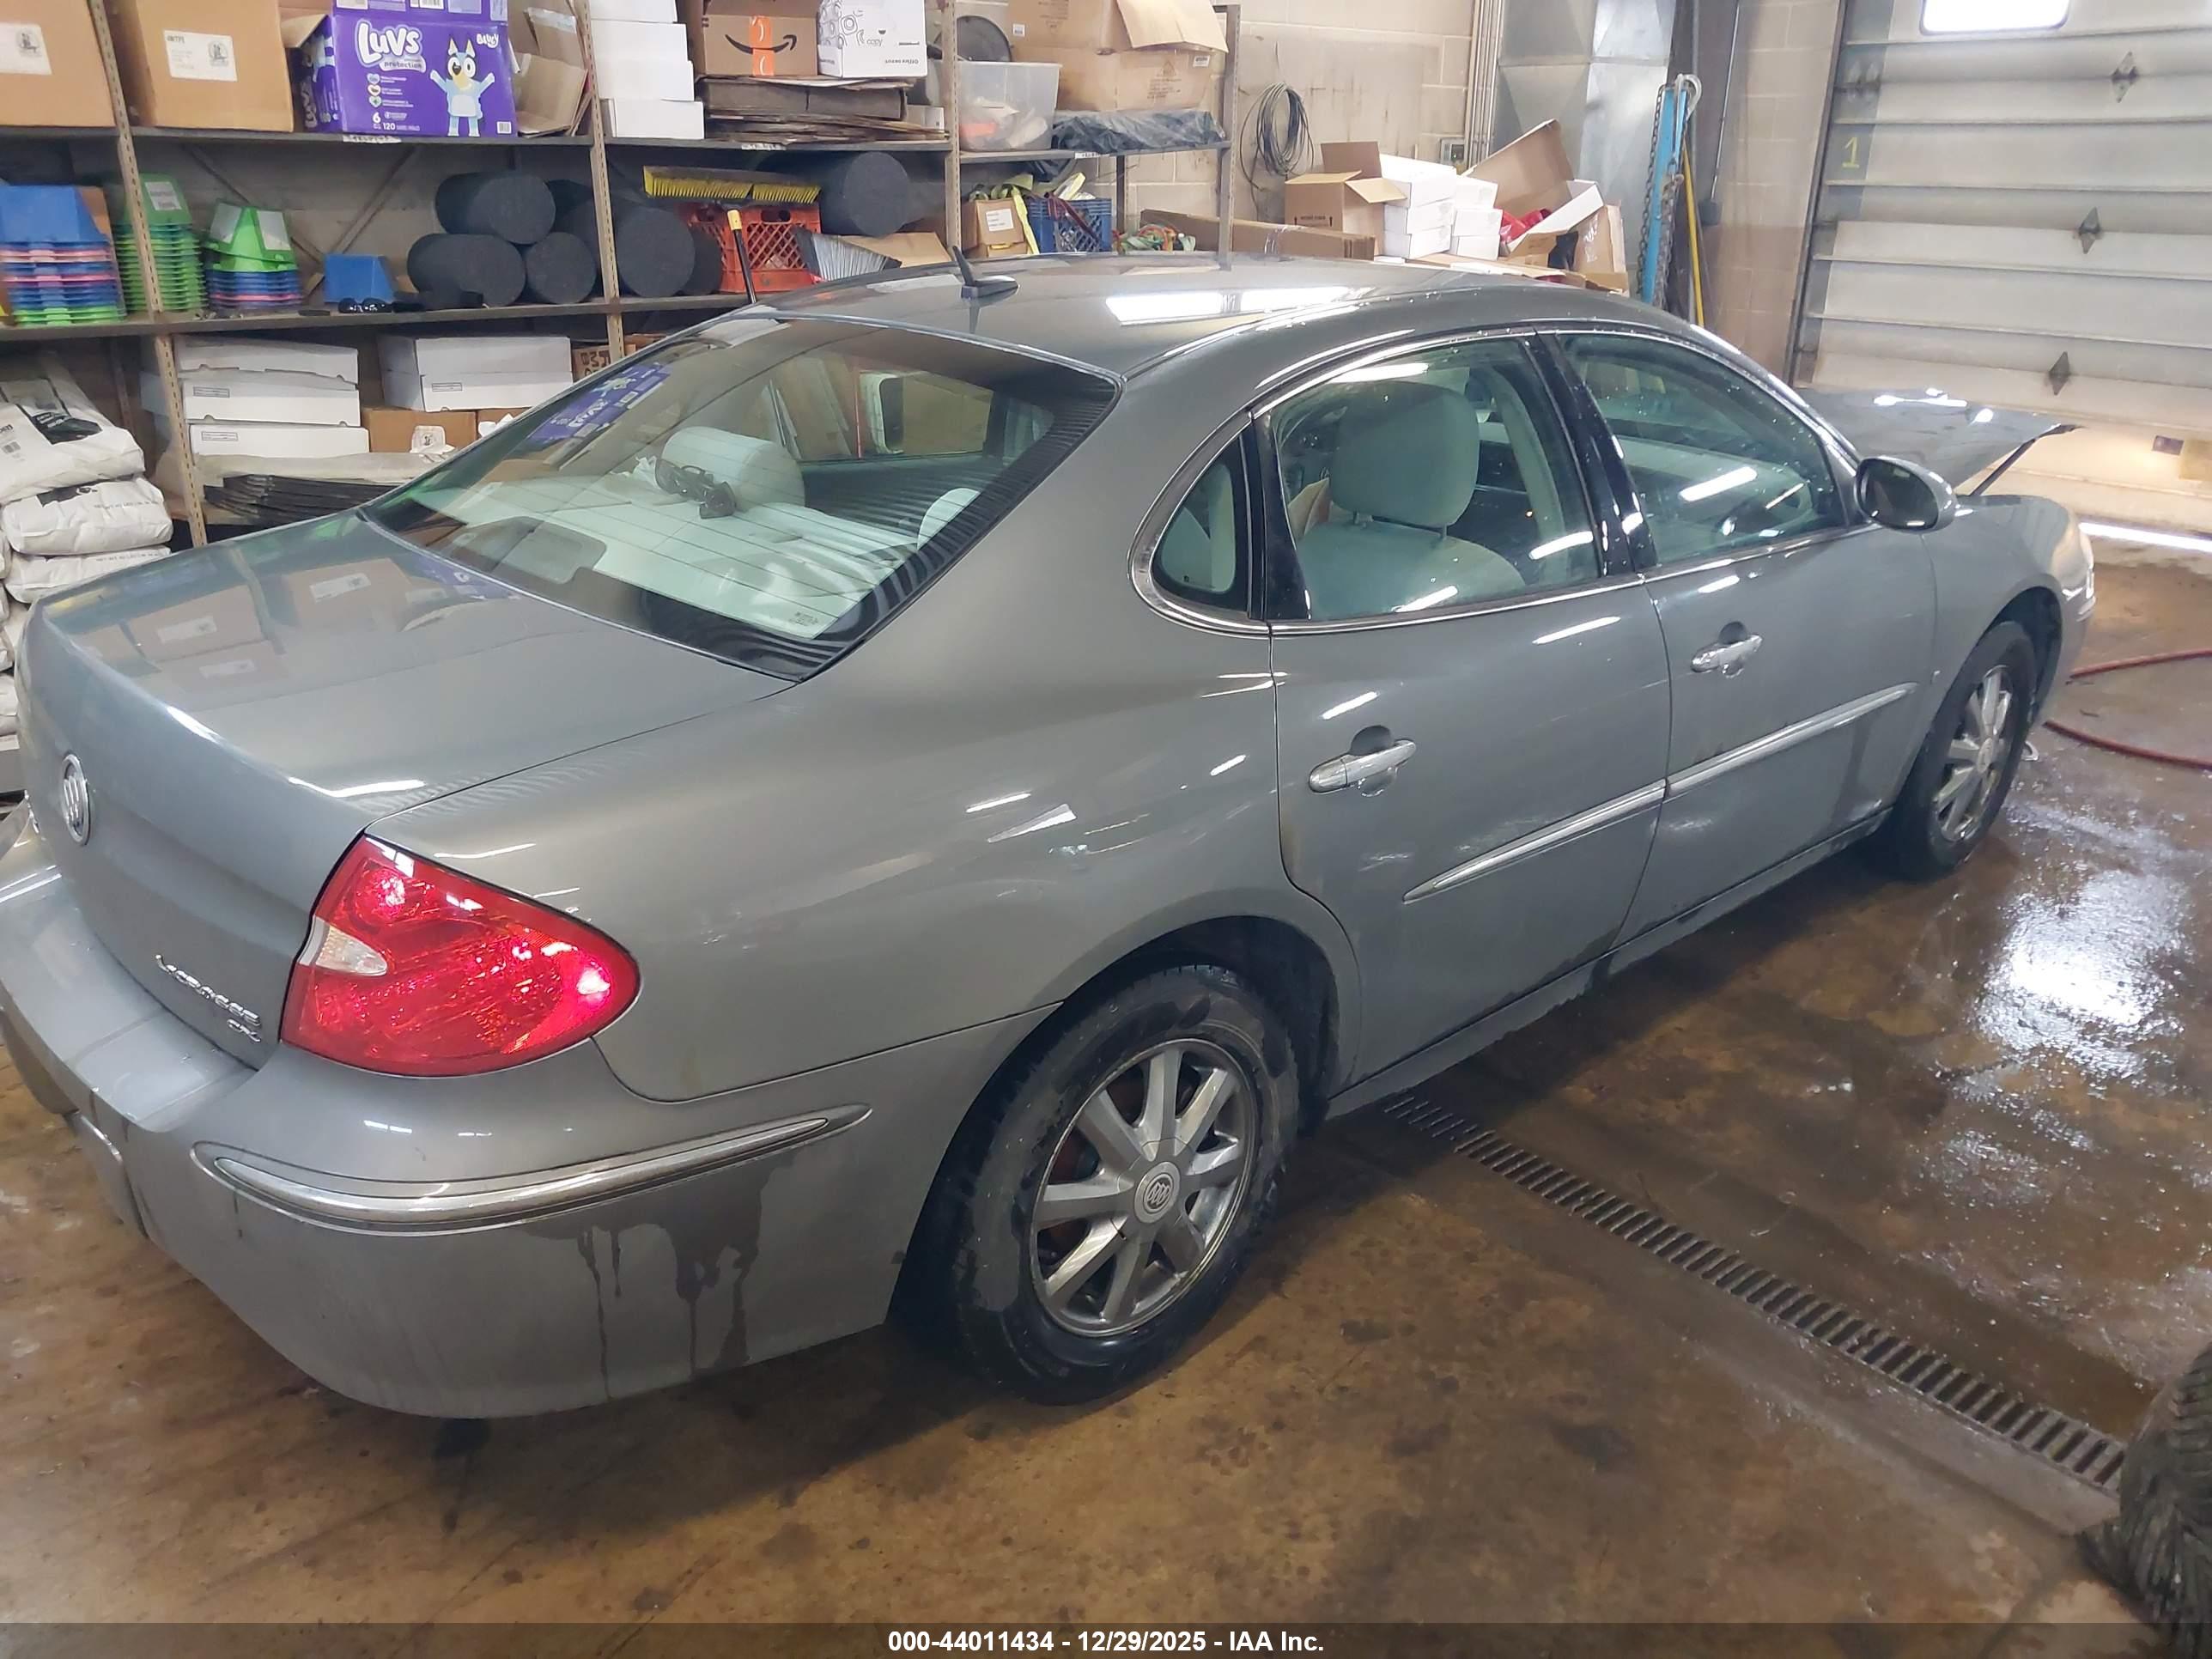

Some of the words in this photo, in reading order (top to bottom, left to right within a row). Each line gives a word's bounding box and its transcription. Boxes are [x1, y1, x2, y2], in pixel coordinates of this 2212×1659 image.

[356, 21, 420, 64] Luvs
[373, 112, 381, 124] 6
[383, 122, 396, 131] 120
[1842, 137, 1860, 169] 1
